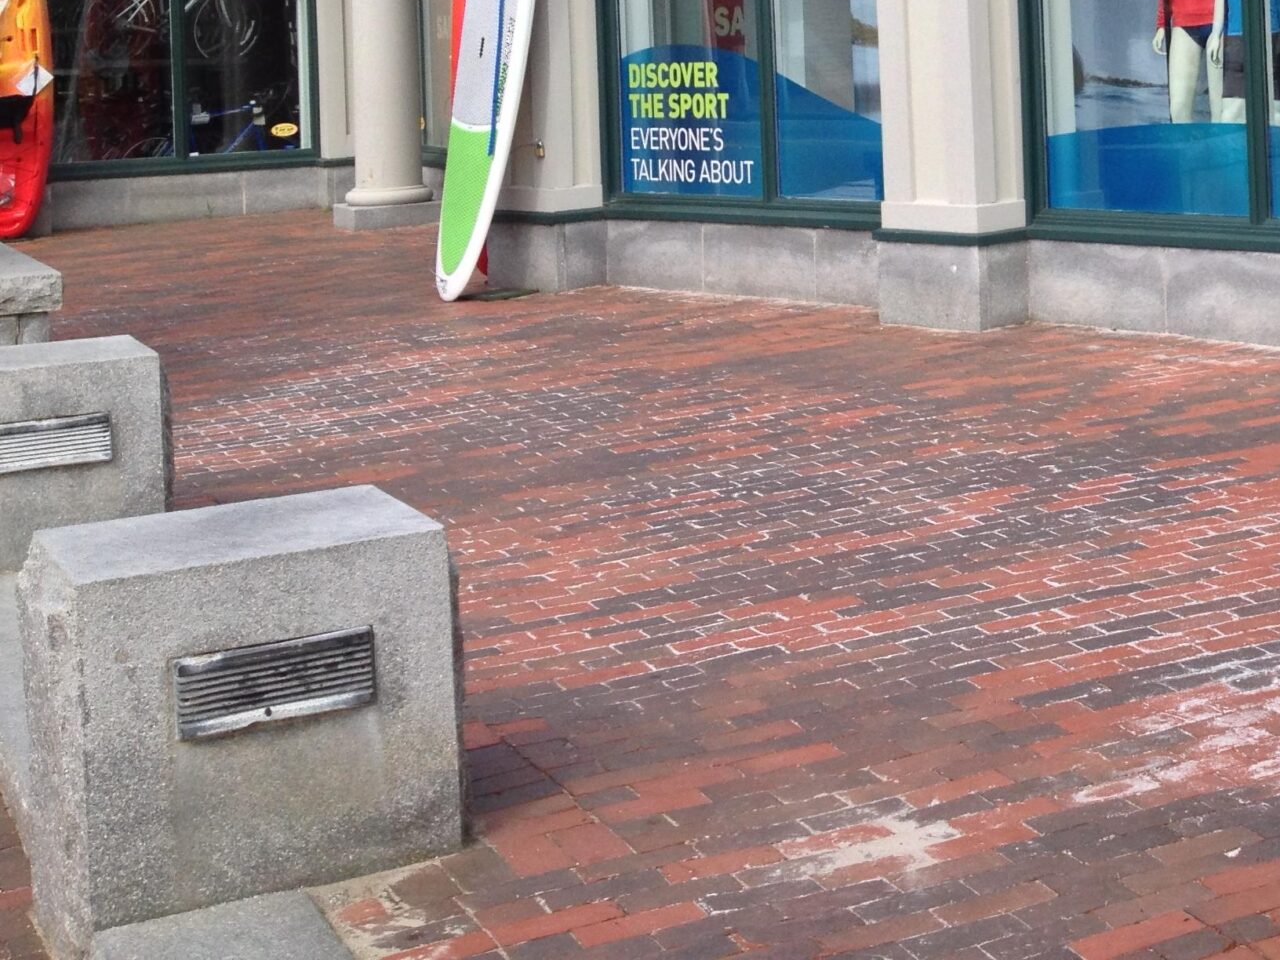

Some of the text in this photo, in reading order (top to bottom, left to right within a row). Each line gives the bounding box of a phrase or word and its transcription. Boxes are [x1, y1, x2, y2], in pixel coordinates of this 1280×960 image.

[628, 61, 719, 89] DISCOVER
[628, 92, 729, 120] THE SPORT
[630, 127, 724, 152] EVERYONE'S
[630, 157, 754, 185] TALKING ABOUT
